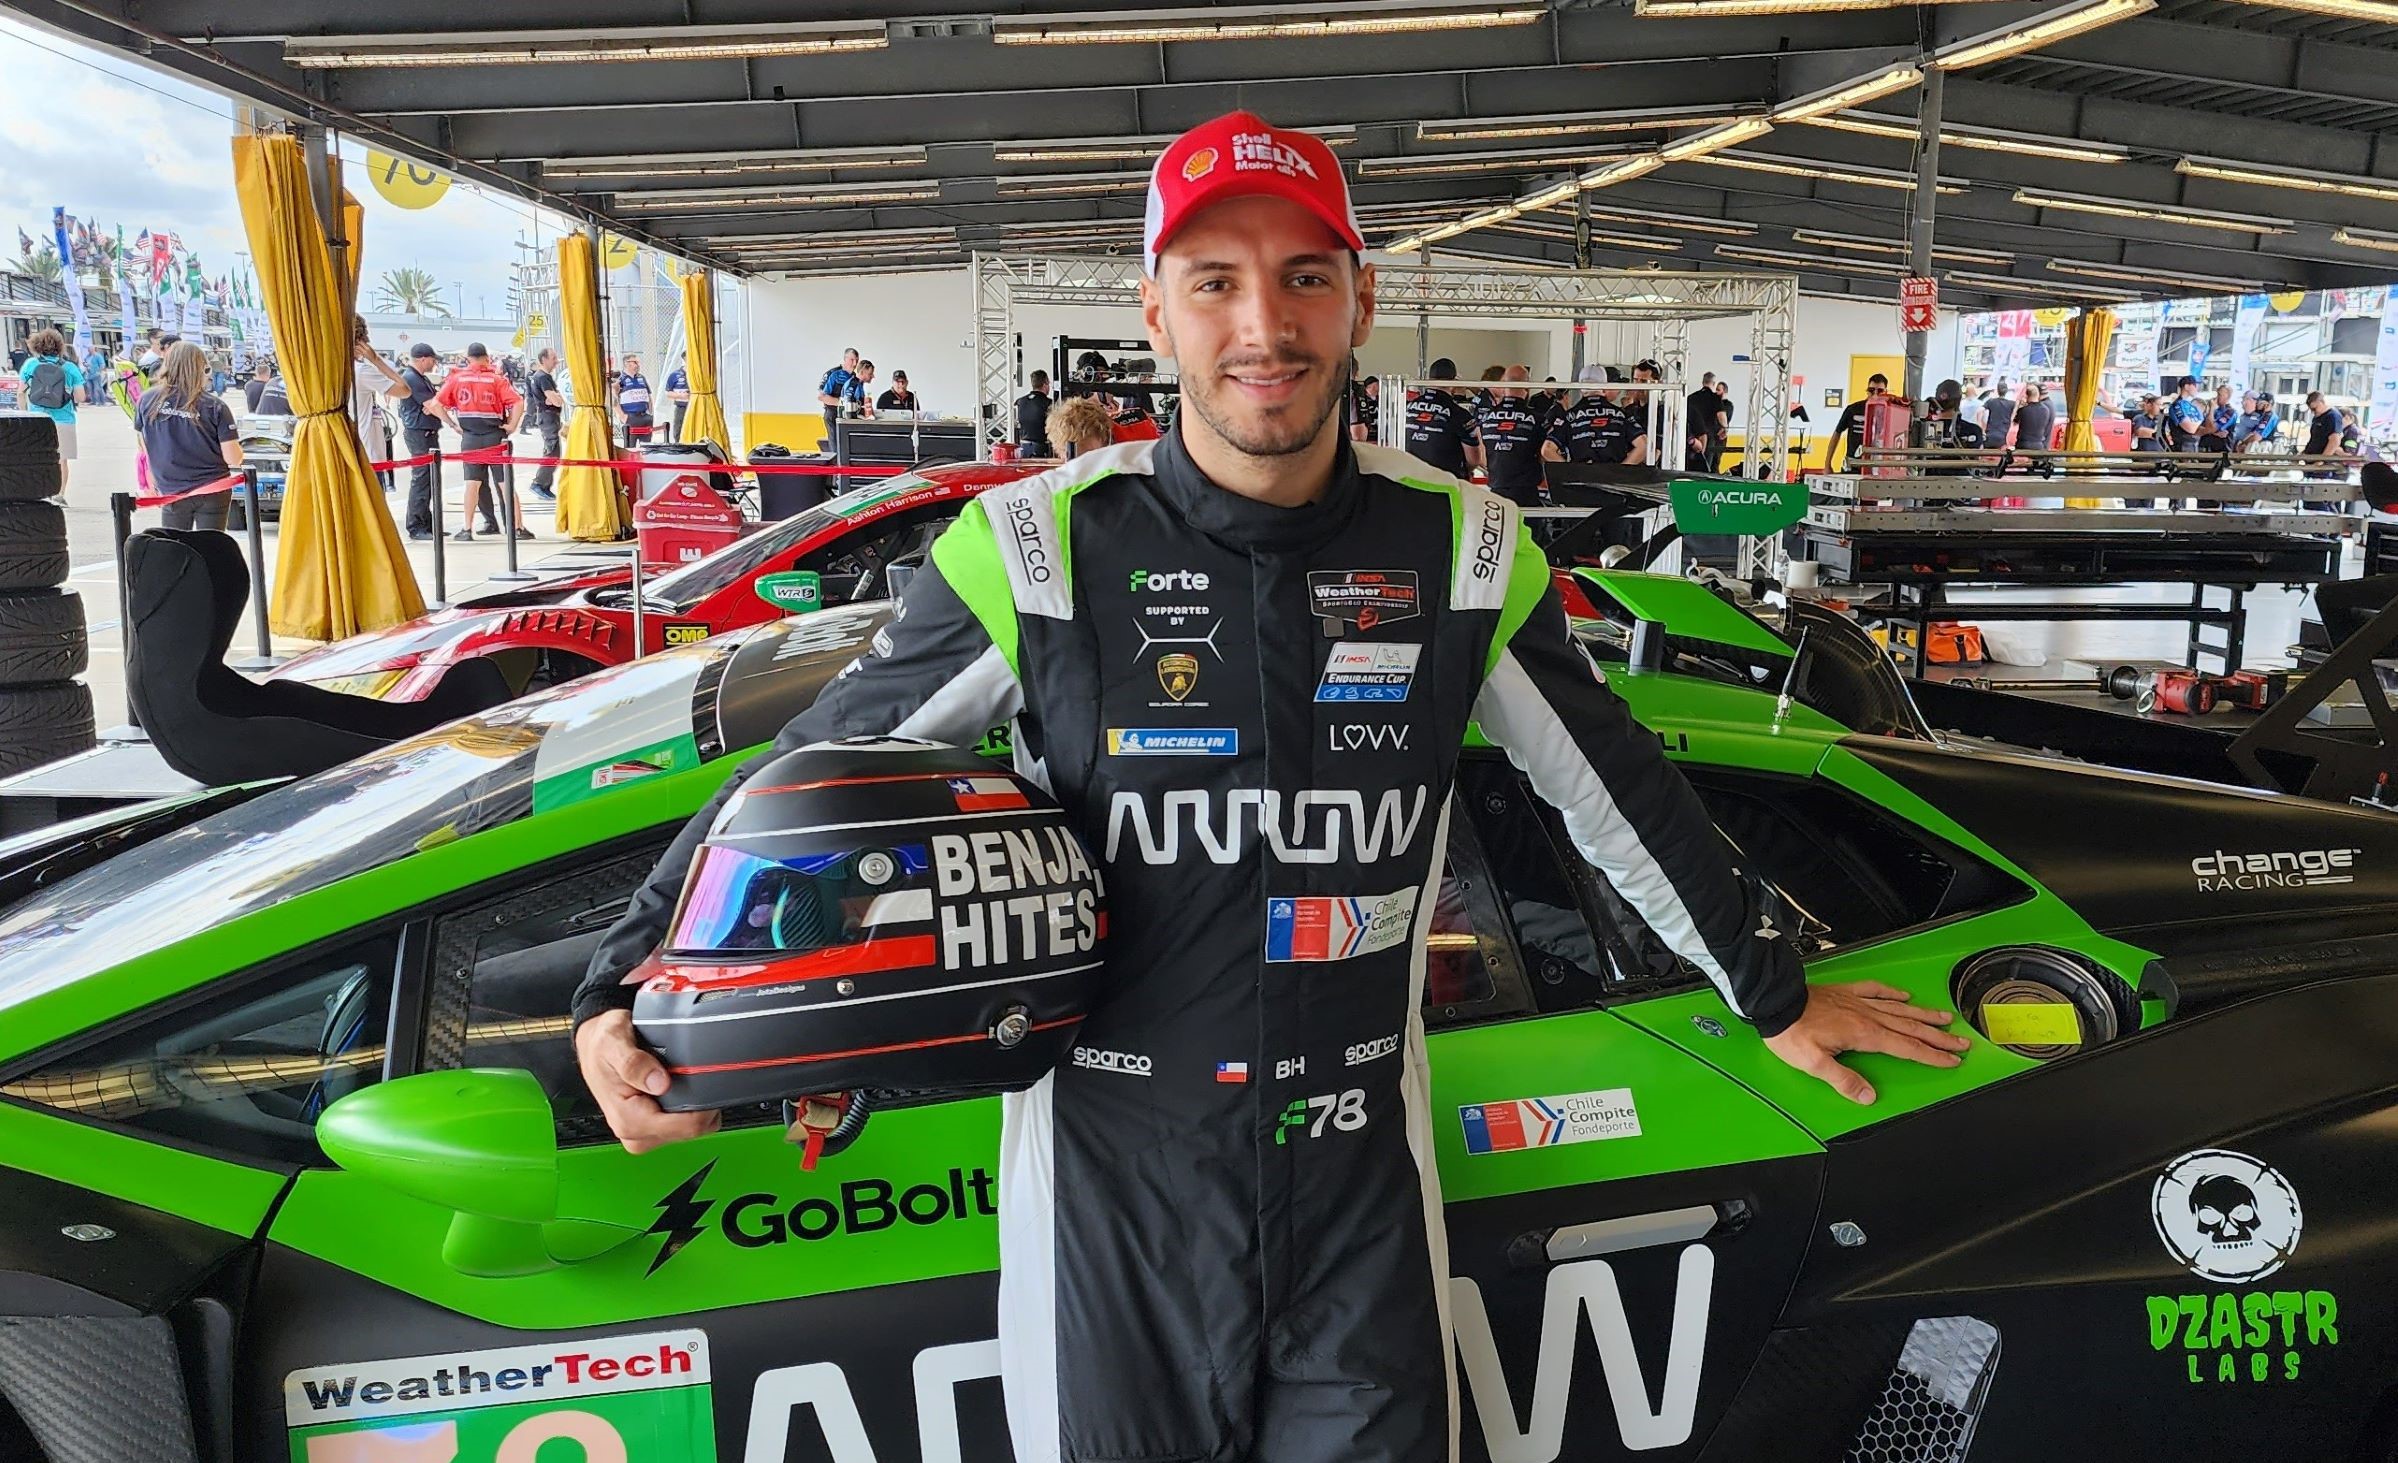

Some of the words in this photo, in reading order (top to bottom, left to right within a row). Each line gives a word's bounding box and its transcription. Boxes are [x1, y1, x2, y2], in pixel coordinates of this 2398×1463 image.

[1233, 142, 1314, 176] HELIX
[1909, 283, 1929, 295] FIRE
[1488, 410, 1536, 425] ACURA
[1575, 408, 1626, 420] ACURA
[846, 504, 885, 527] Ashton
[885, 490, 934, 511] Harrison
[1711, 491, 1782, 505] ACURA
[1008, 497, 1051, 584] sparco
[1472, 500, 1502, 580] sparco
[1129, 568, 1211, 593] Forte
[1314, 587, 1415, 600] WeatherTech
[1145, 606, 1210, 616] SUPPORTED
[1169, 616, 1185, 626] BY
[1143, 735, 1227, 749] MICHELIN
[1105, 784, 1427, 865] ARROW
[931, 825, 1094, 898] BENJA
[2191, 849, 2354, 877] change
[2197, 873, 2304, 893] RACING
[1373, 896, 1400, 917] Chile
[938, 888, 1099, 971] HITES
[1370, 907, 1412, 932] Compite
[1072, 1046, 1152, 1072] sparco
[1344, 1033, 1400, 1064] sparco
[1275, 1056, 1306, 1080] BH
[1566, 1096, 1604, 1112] Chile
[1569, 1107, 1635, 1124] Compite
[1572, 1120, 1635, 1137] Fondeporte
[720, 1167, 998, 1249] GoBolt
[2146, 1289, 2339, 1351] DZASTR
[301, 1343, 693, 1411] WeatherTech
[2187, 1351, 2301, 1383] LABS
